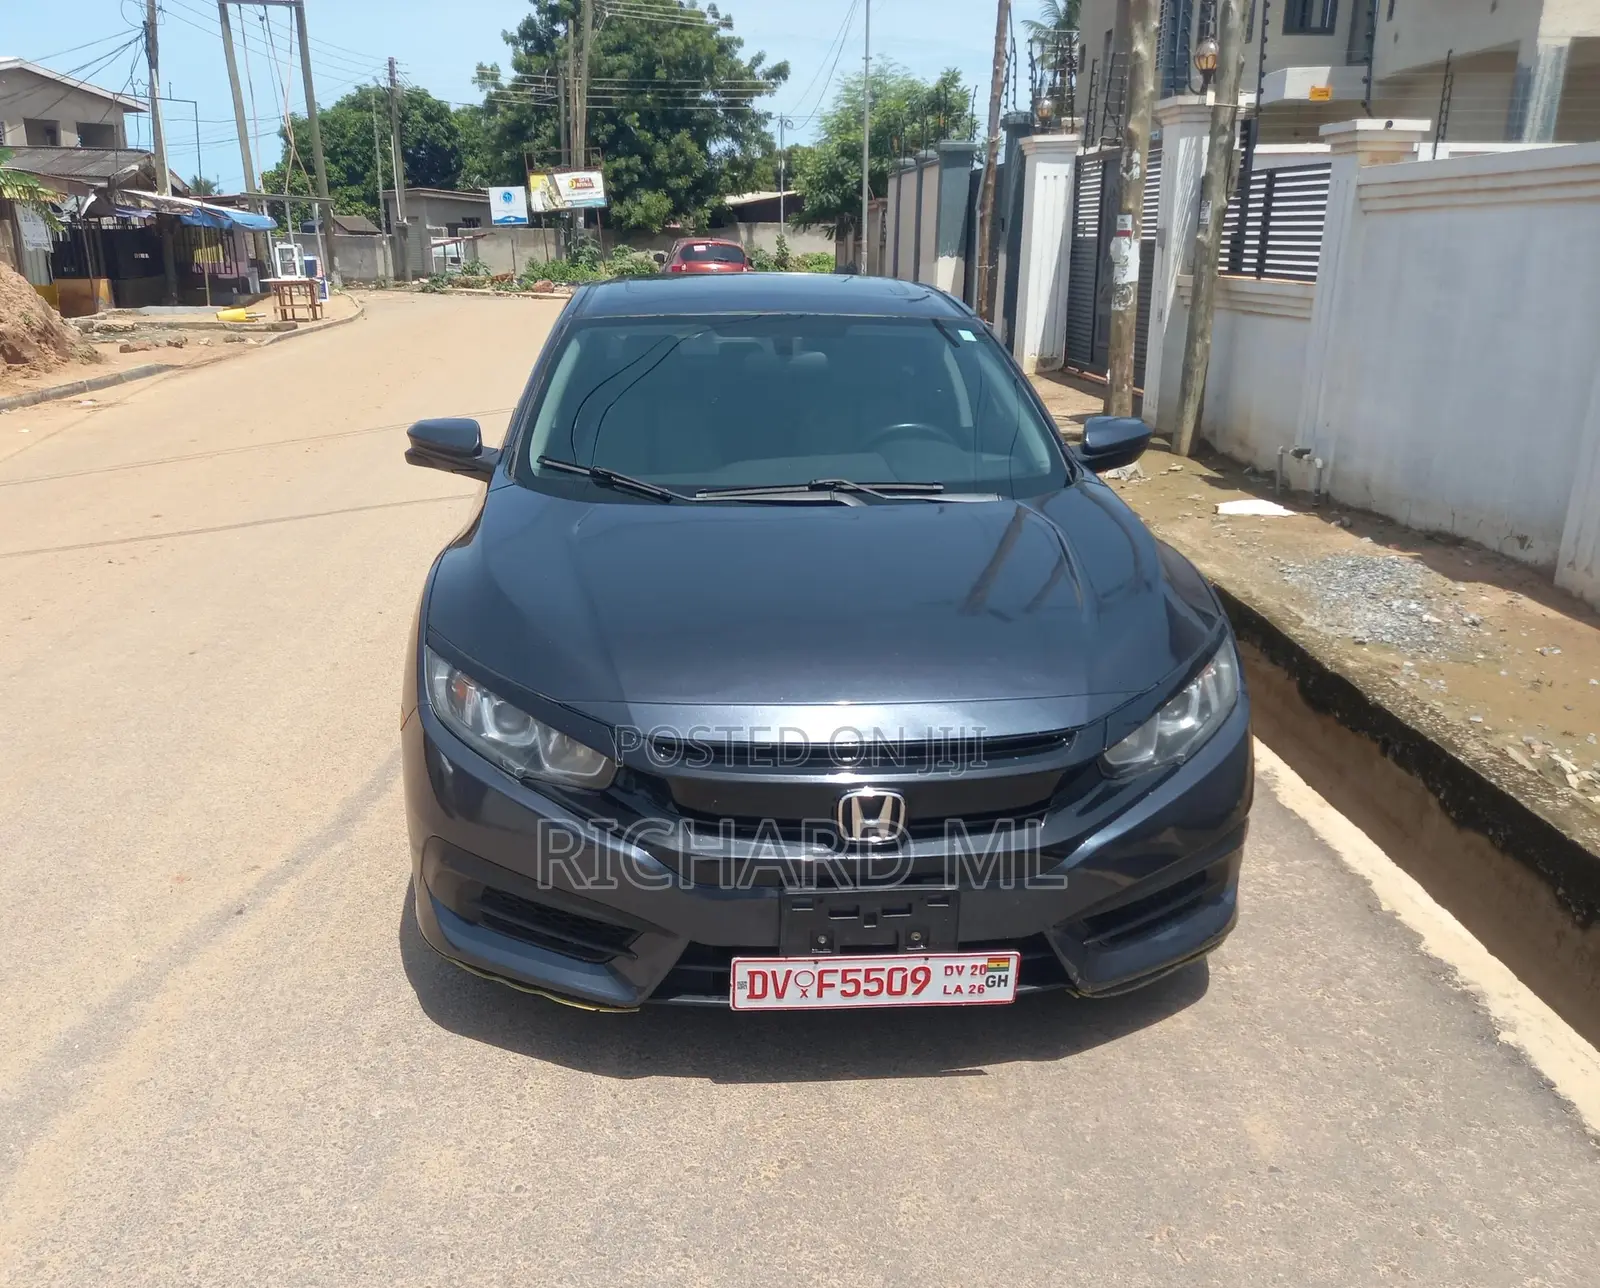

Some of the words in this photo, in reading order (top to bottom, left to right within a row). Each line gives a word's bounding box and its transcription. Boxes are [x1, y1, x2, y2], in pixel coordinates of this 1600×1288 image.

[944, 965, 965, 976] DV
[746, 970, 793, 999] DV
[816, 965, 932, 998] F5509
[985, 974, 1009, 988] GH
[943, 984, 963, 995] LA
[968, 984, 985, 994] 26
